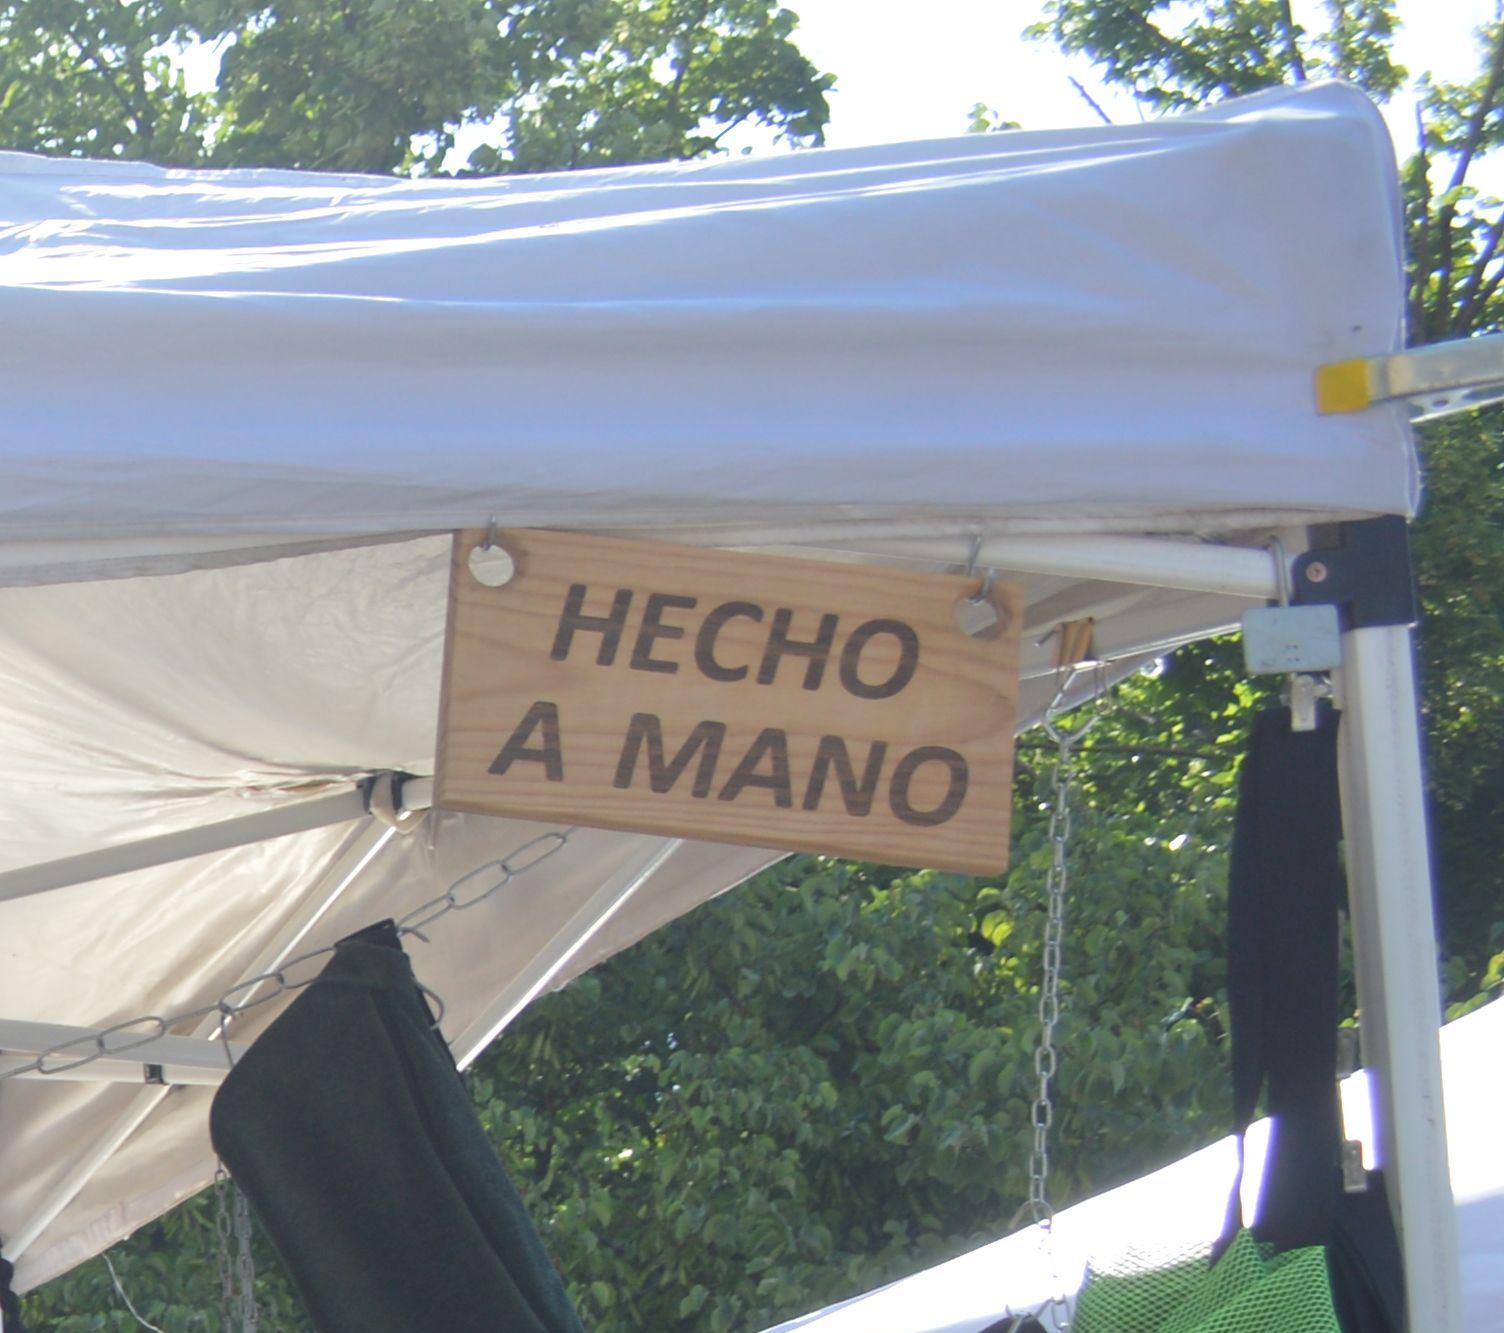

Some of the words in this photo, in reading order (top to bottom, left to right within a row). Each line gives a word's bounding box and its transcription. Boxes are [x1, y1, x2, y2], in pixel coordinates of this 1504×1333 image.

[549, 583, 920, 700] HECHO
[487, 701, 564, 782] A
[613, 712, 969, 827] MANO
